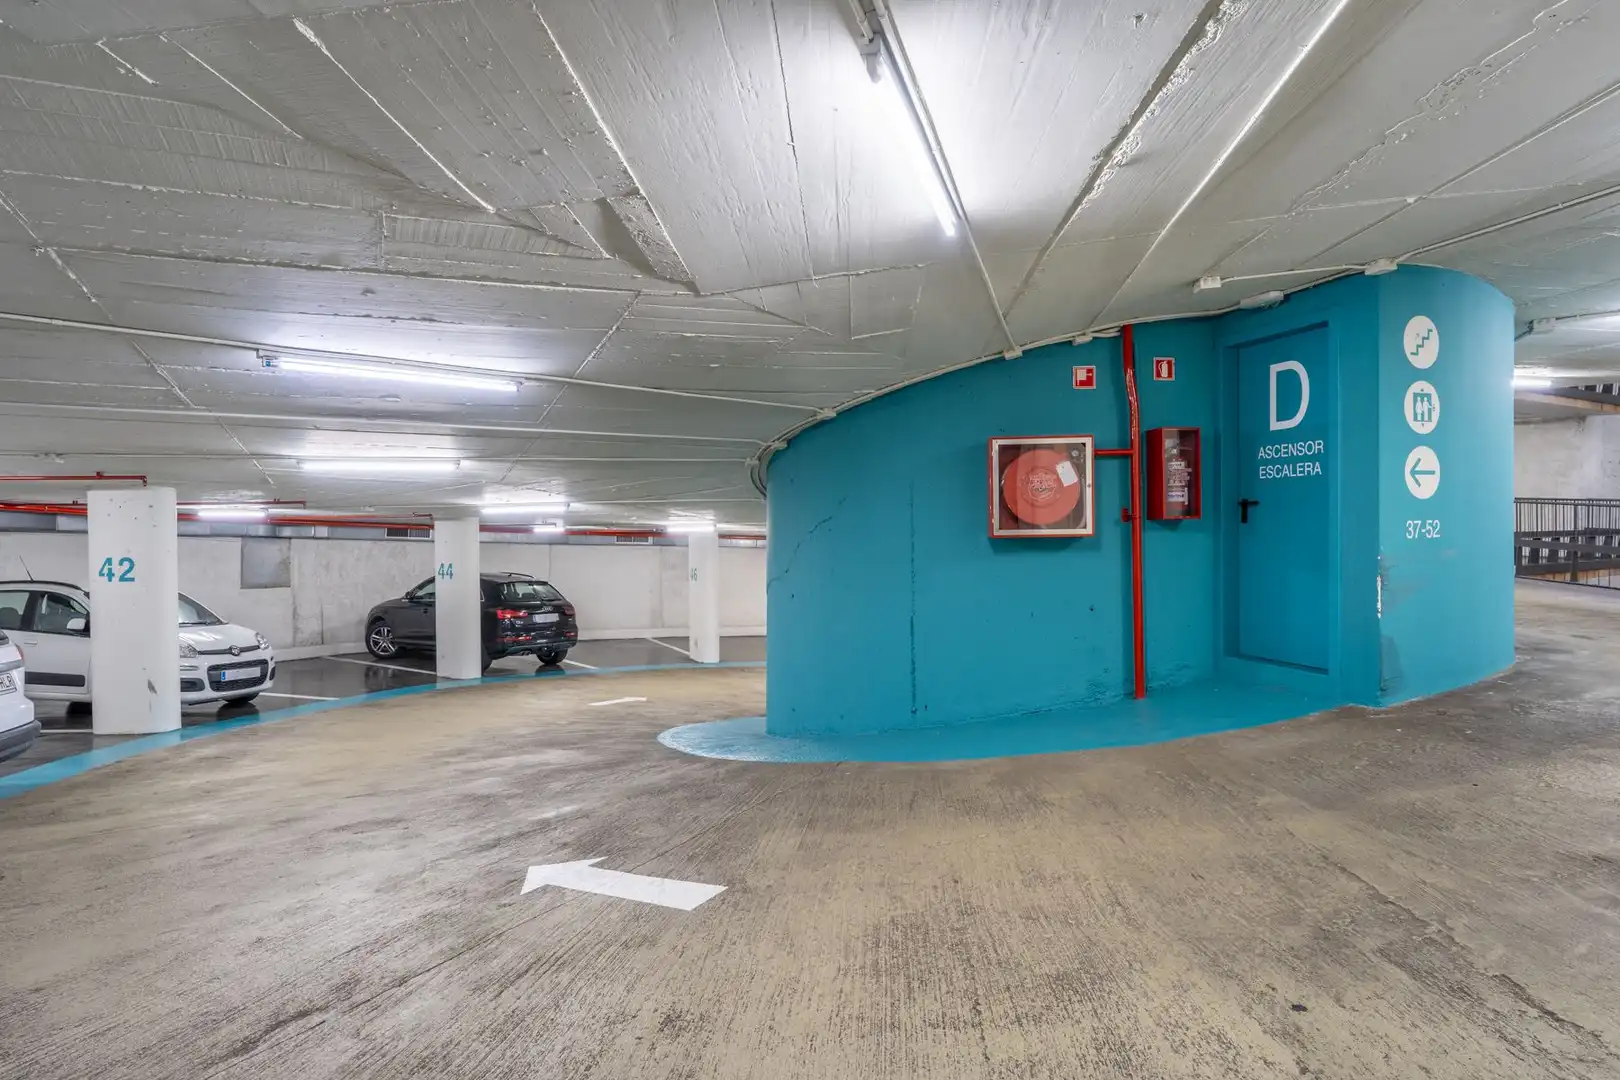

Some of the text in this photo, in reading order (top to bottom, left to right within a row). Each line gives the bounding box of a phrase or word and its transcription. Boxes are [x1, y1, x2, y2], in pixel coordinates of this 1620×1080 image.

[1270, 360, 1310, 431] D
[1258, 440, 1324, 460] ASCENSOR
[1259, 462, 1322, 479] ESCALERA
[1406, 519, 1440, 539] 37-52
[98, 557, 135, 582] 42
[437, 563, 453, 580] 44
